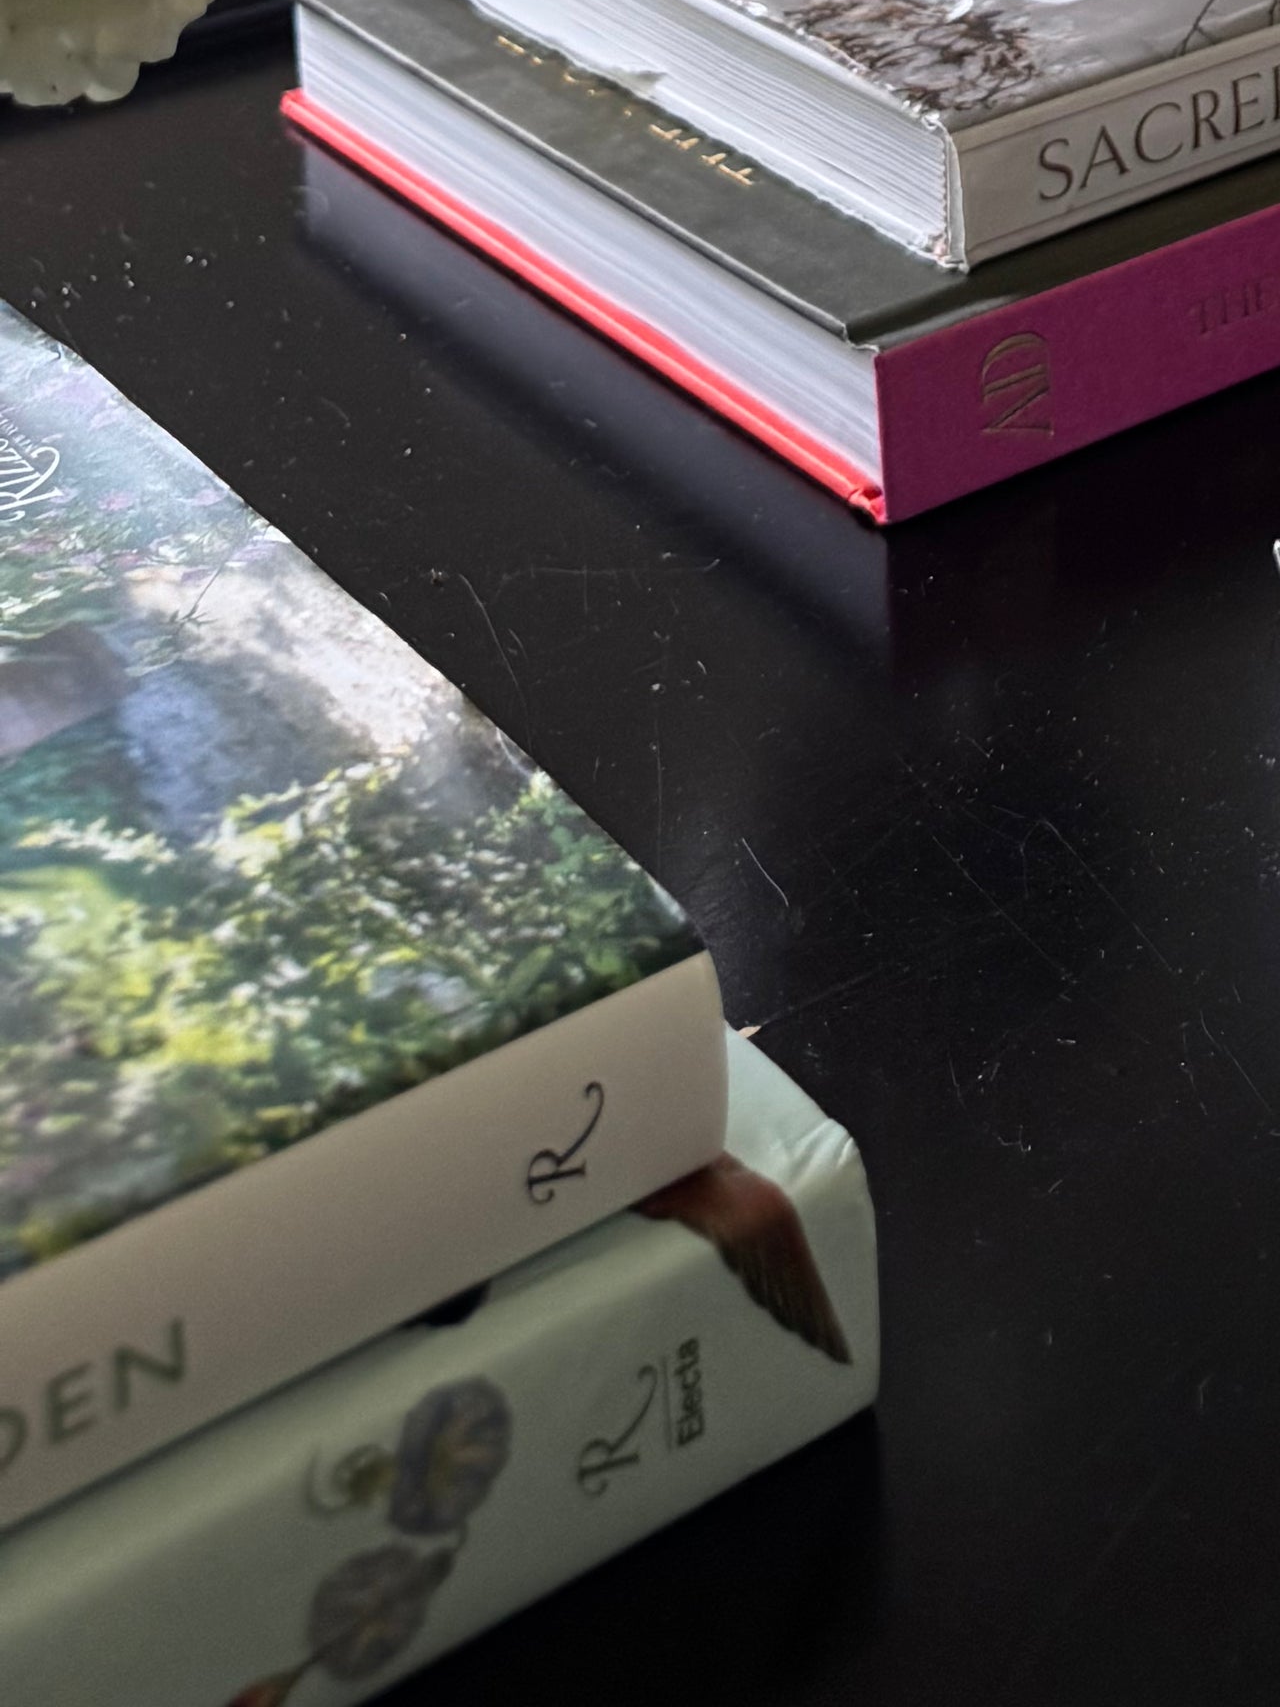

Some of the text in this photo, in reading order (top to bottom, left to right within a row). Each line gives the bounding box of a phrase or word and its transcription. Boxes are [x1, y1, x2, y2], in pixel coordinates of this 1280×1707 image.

[527, 1081, 605, 1206] R
[576, 1364, 658, 1497] R
[676, 1337, 705, 1448] Electa
